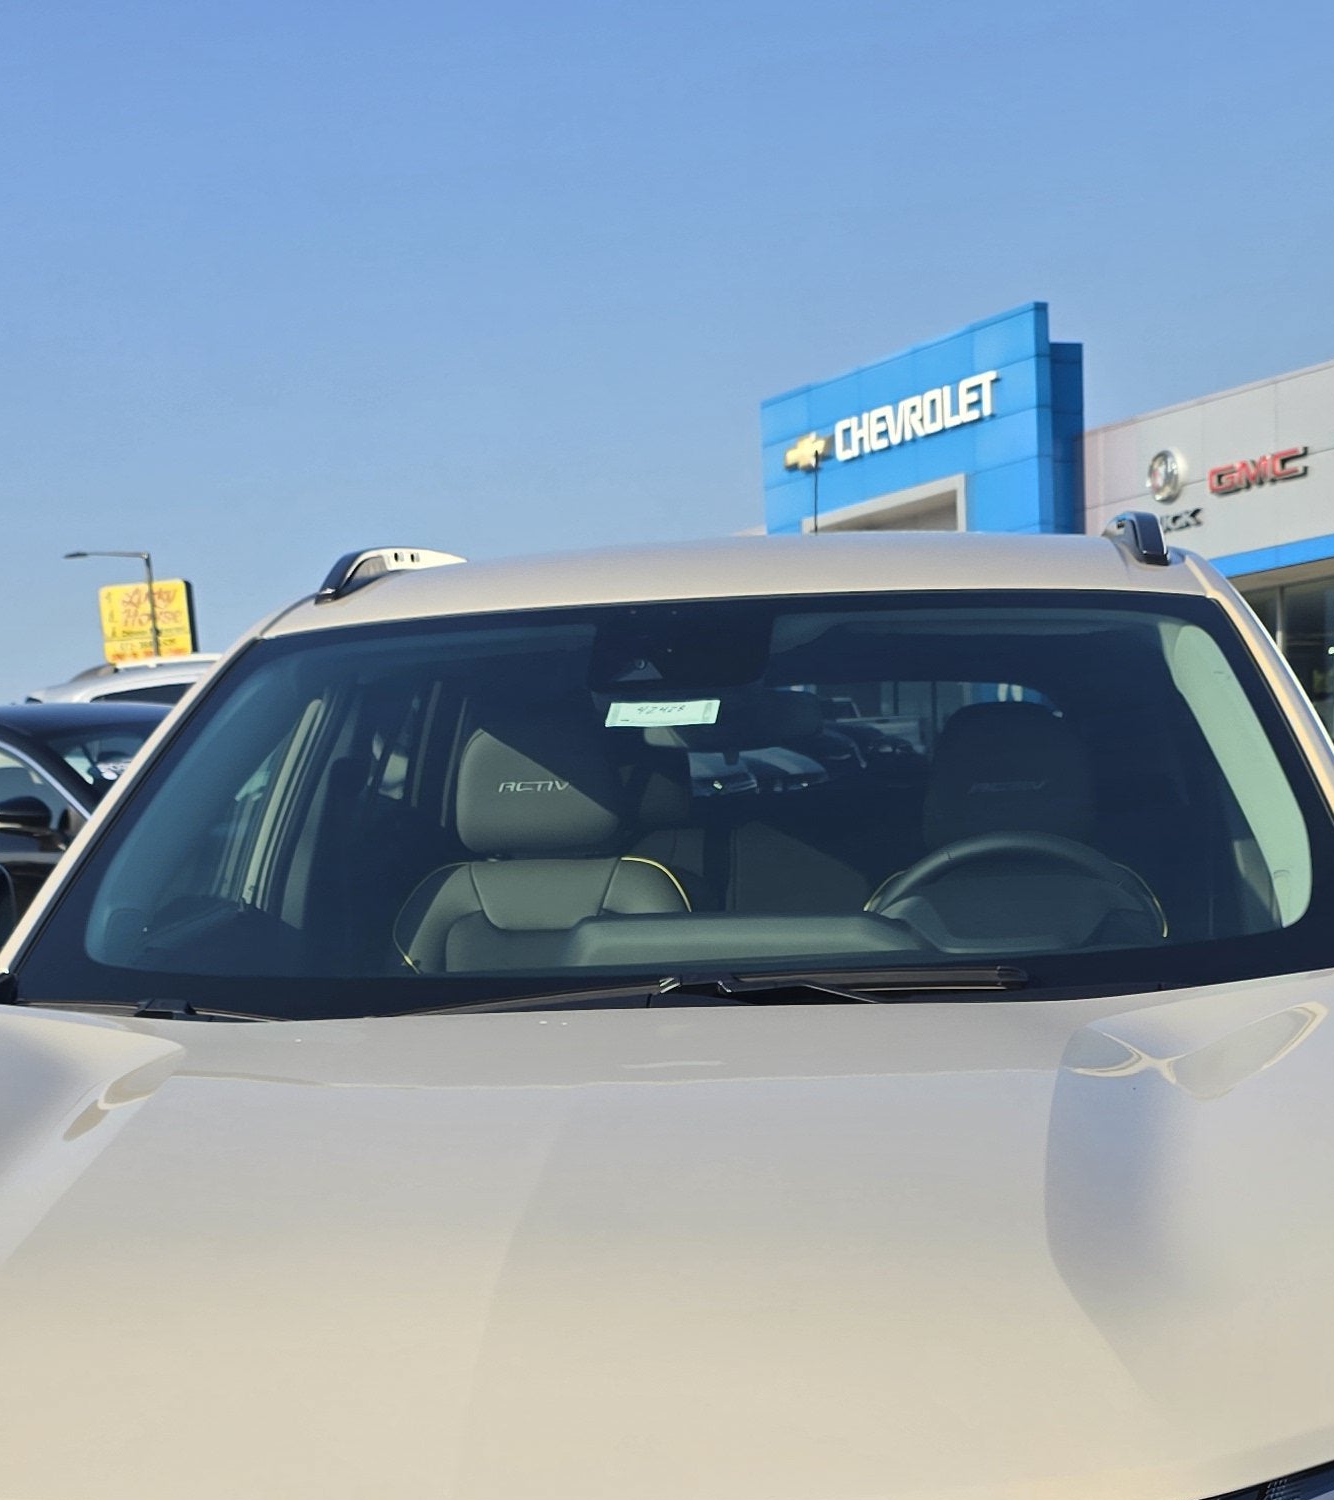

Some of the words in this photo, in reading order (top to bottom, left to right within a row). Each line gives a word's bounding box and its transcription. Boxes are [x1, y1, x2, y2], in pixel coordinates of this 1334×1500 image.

[834, 370, 998, 462] CHEVROLET
[1208, 447, 1308, 495] GMC
[1163, 507, 1203, 533] ICK
[498, 780, 569, 793] ACTIV
